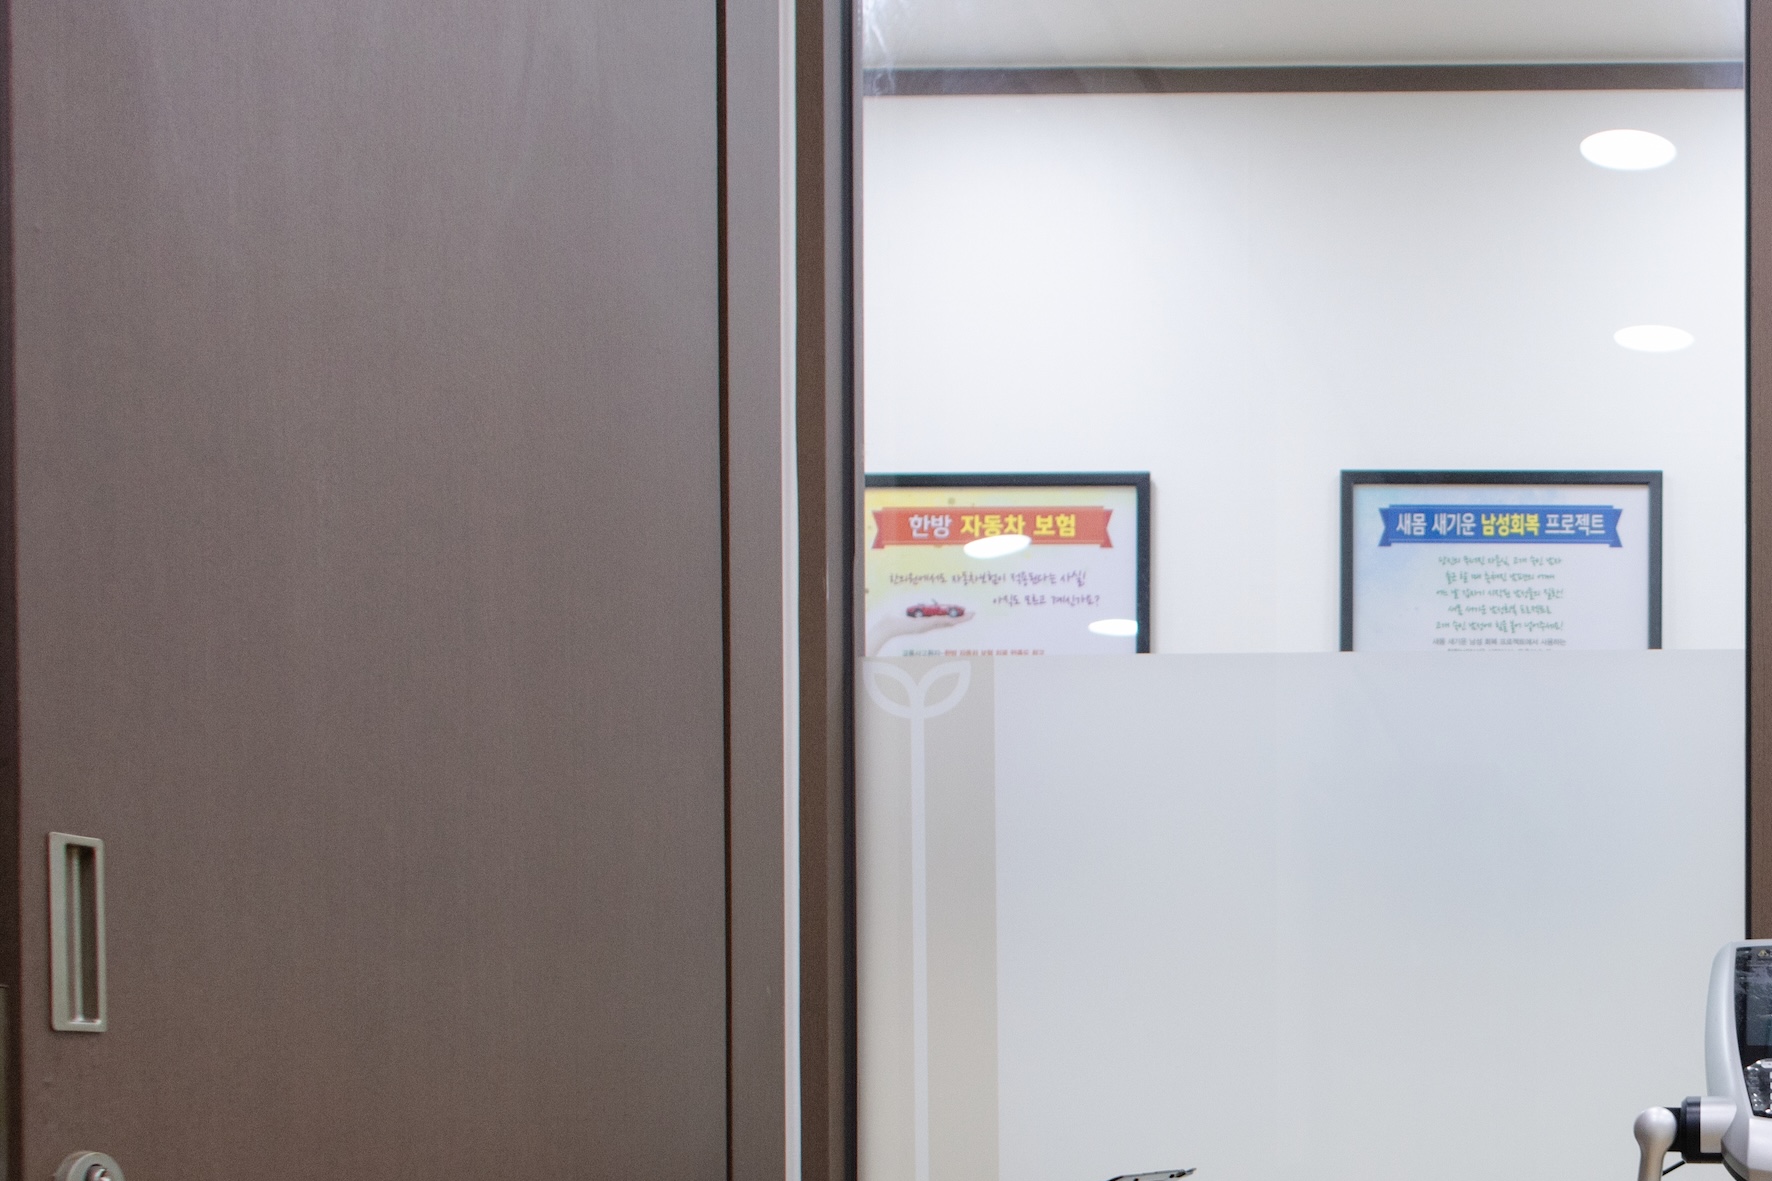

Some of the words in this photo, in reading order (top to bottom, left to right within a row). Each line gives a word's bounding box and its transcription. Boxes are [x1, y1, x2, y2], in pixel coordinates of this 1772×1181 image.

[908, 514, 951, 538] 한방
[960, 514, 1025, 537] 자동차
[1033, 514, 1076, 537] 보험
[1396, 513, 1426, 536] 새몸
[1431, 513, 1475, 535] 새기운
[1481, 513, 1540, 536] 남성회복
[1545, 513, 1605, 535] 프로젝트
[890, 572, 947, 585] 한의원에서도
[951, 571, 1006, 586] 자동차보험이
[1060, 570, 1087, 587] 사실!
[993, 594, 1020, 607] 아직도
[1024, 594, 1046, 605] 모르고
[1051, 594, 1100, 607] 계신가요?
[1465, 604, 1486, 615] 새기운
